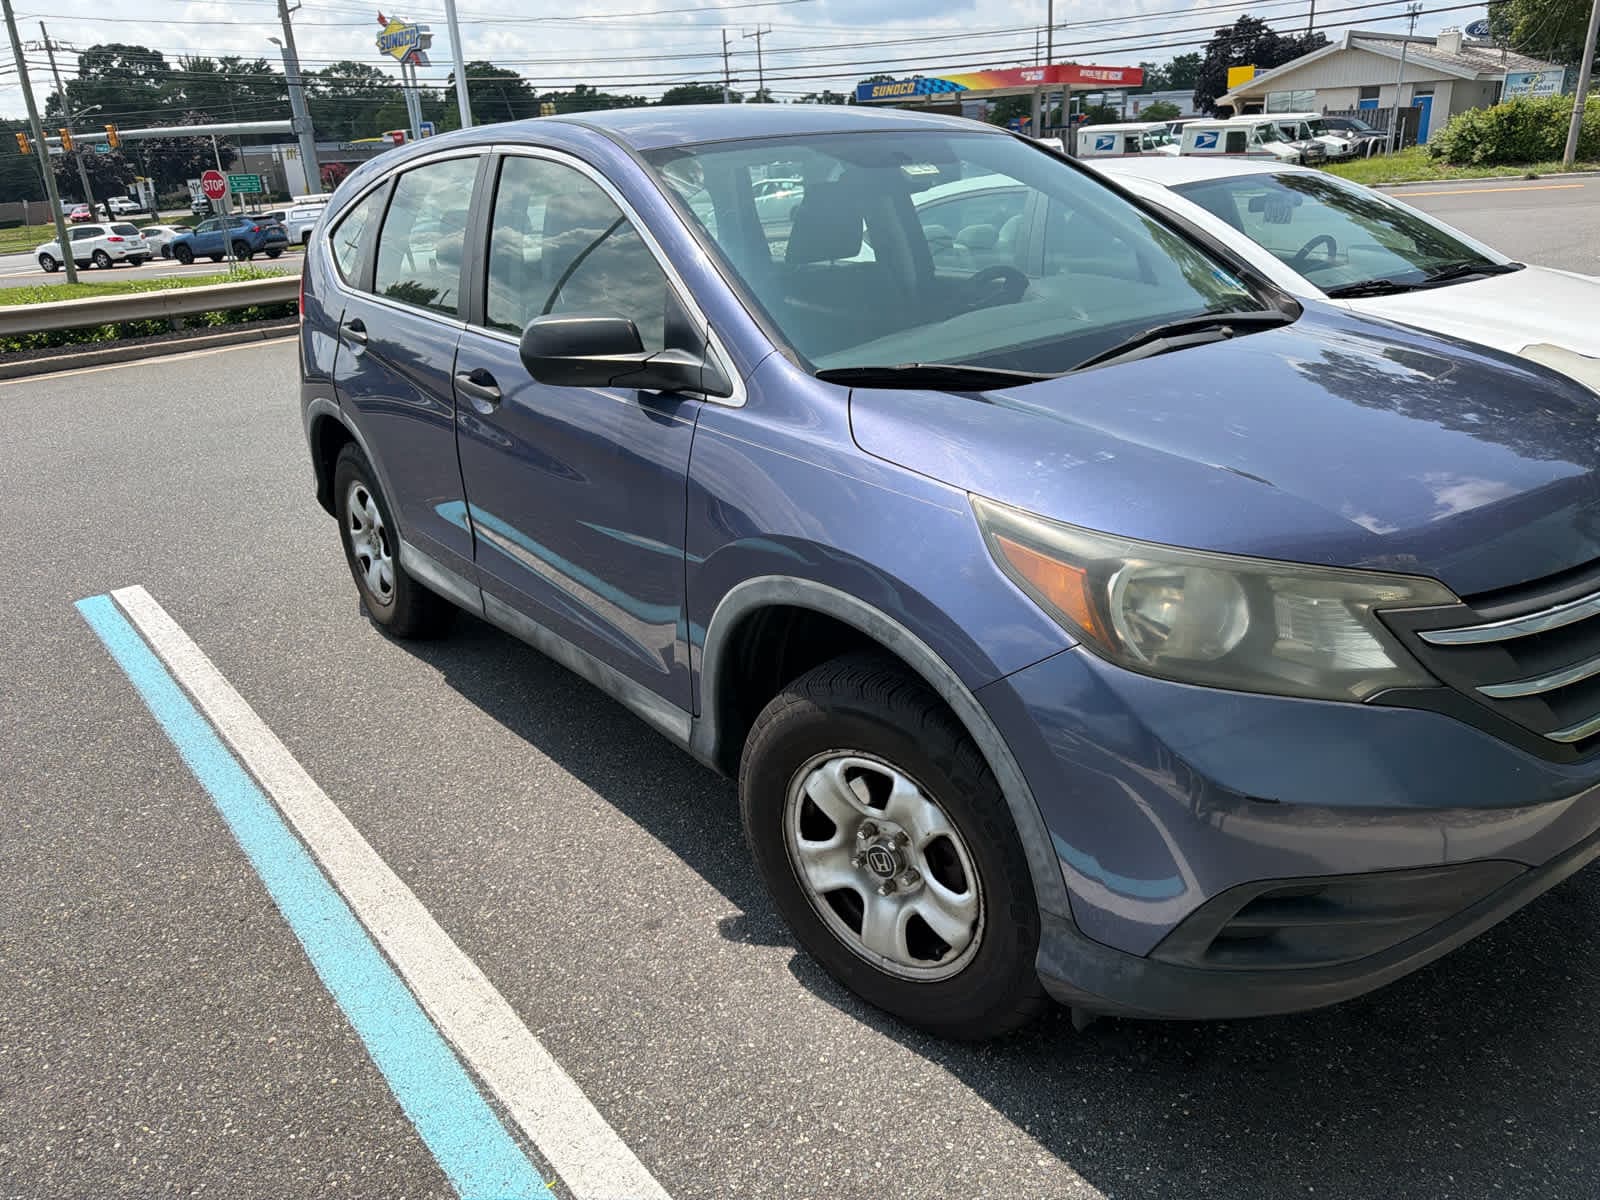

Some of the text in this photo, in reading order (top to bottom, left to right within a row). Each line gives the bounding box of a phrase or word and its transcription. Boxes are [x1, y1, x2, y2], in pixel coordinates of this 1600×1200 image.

[380, 29, 416, 50] SUNOCO
[872, 82, 915, 97] SUNOCO
[1510, 85, 1532, 95] Jerse
[203, 179, 224, 192] STOP
